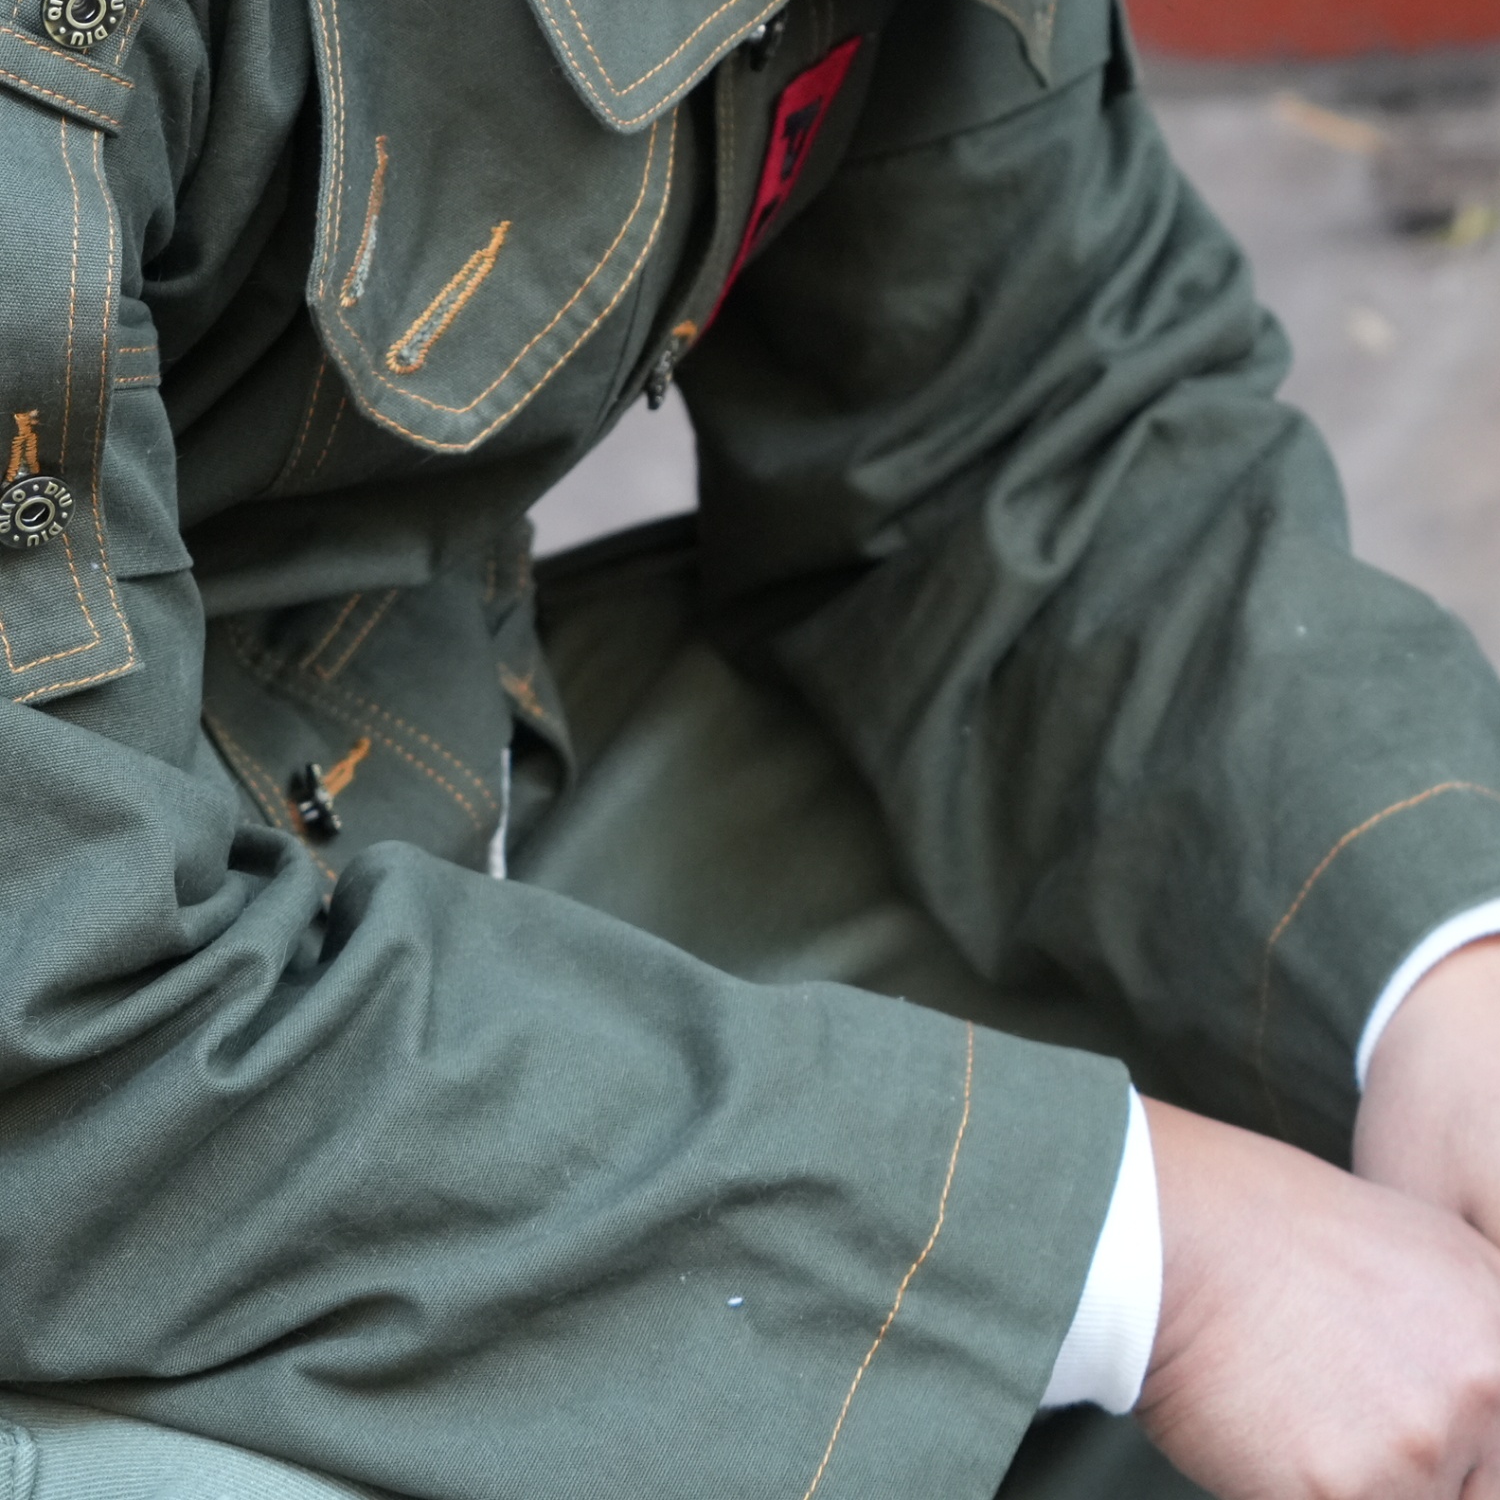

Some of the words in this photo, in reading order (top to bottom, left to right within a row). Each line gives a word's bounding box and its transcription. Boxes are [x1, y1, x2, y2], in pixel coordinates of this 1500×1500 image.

[70, 24, 109, 46] DIU
[43, 480, 73, 508] DIU
[26, 521, 63, 547] DIU
